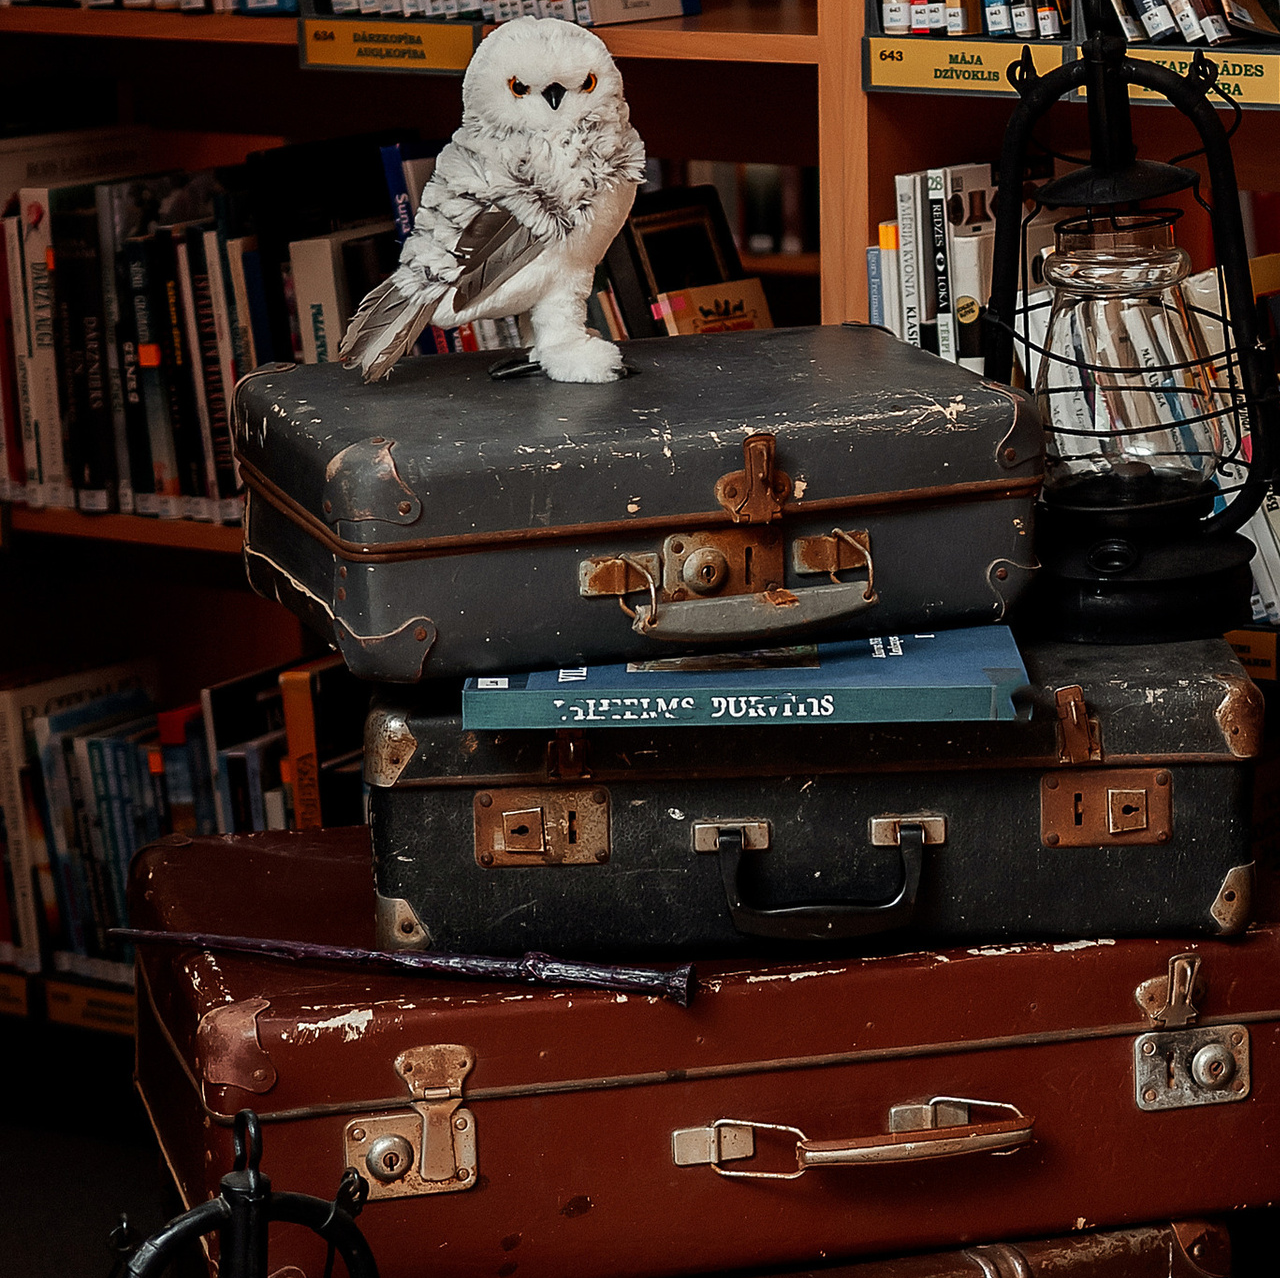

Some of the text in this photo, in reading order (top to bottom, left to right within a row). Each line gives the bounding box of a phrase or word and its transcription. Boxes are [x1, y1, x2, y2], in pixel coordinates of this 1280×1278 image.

[880, 50, 983, 66] 643 MĀJA
[933, 66, 1000, 82] DZĪVOKLIS
[931, 204, 944, 246] REDZES
[902, 249, 915, 297] KVONTA
